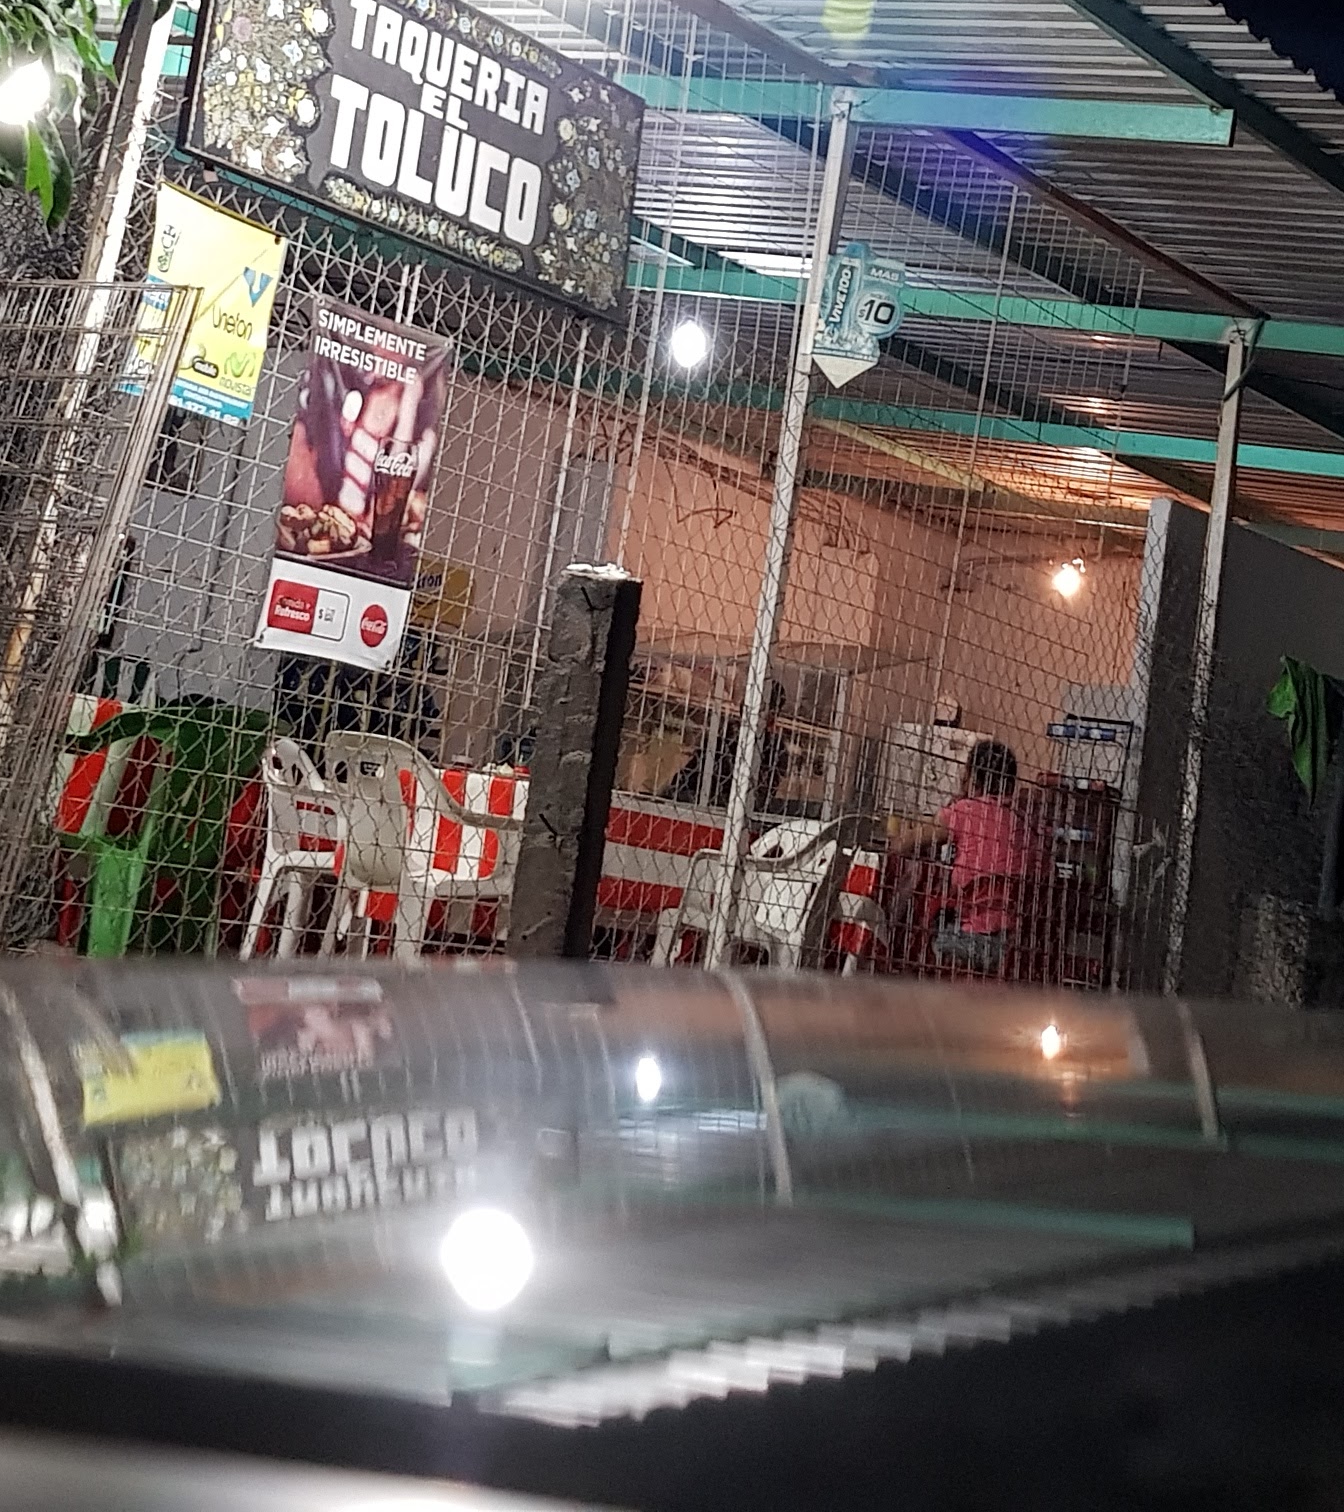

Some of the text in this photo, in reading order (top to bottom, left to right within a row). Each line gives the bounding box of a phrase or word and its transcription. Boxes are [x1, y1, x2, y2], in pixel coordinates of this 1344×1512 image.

[420, 86, 469, 130] EL
[330, 74, 543, 246] TOLUCO
[313, 334, 419, 386] IRRESISTIBLE
[317, 308, 427, 362] SIMPLEMENTE
